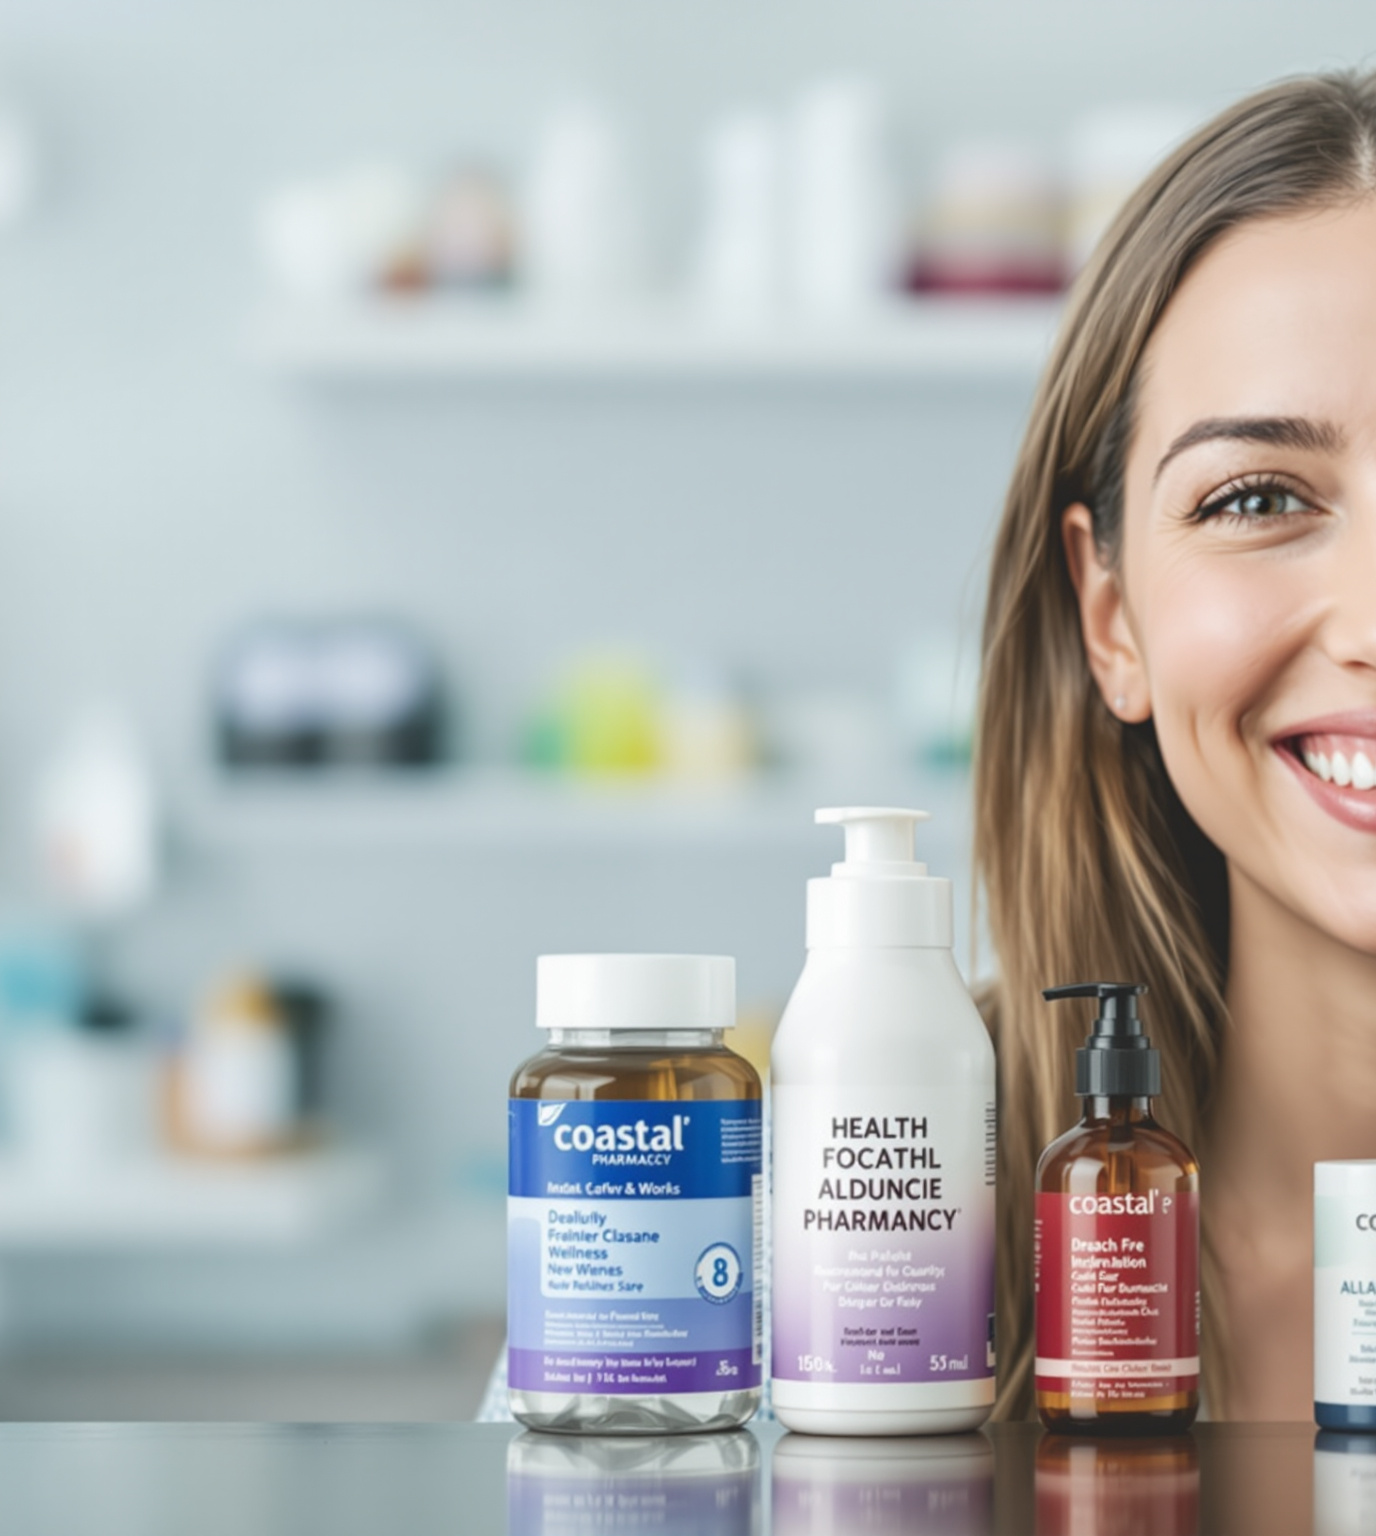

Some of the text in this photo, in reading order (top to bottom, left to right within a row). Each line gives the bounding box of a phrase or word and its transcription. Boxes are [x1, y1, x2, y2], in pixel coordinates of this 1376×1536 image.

[832, 1116, 928, 1139] HEALTH
[823, 1147, 941, 1170] FOCATHL
[818, 1177, 942, 1200] ALDUNCIE
[1069, 1189, 1156, 1215] coastal
[712, 1257, 729, 1287] 8
